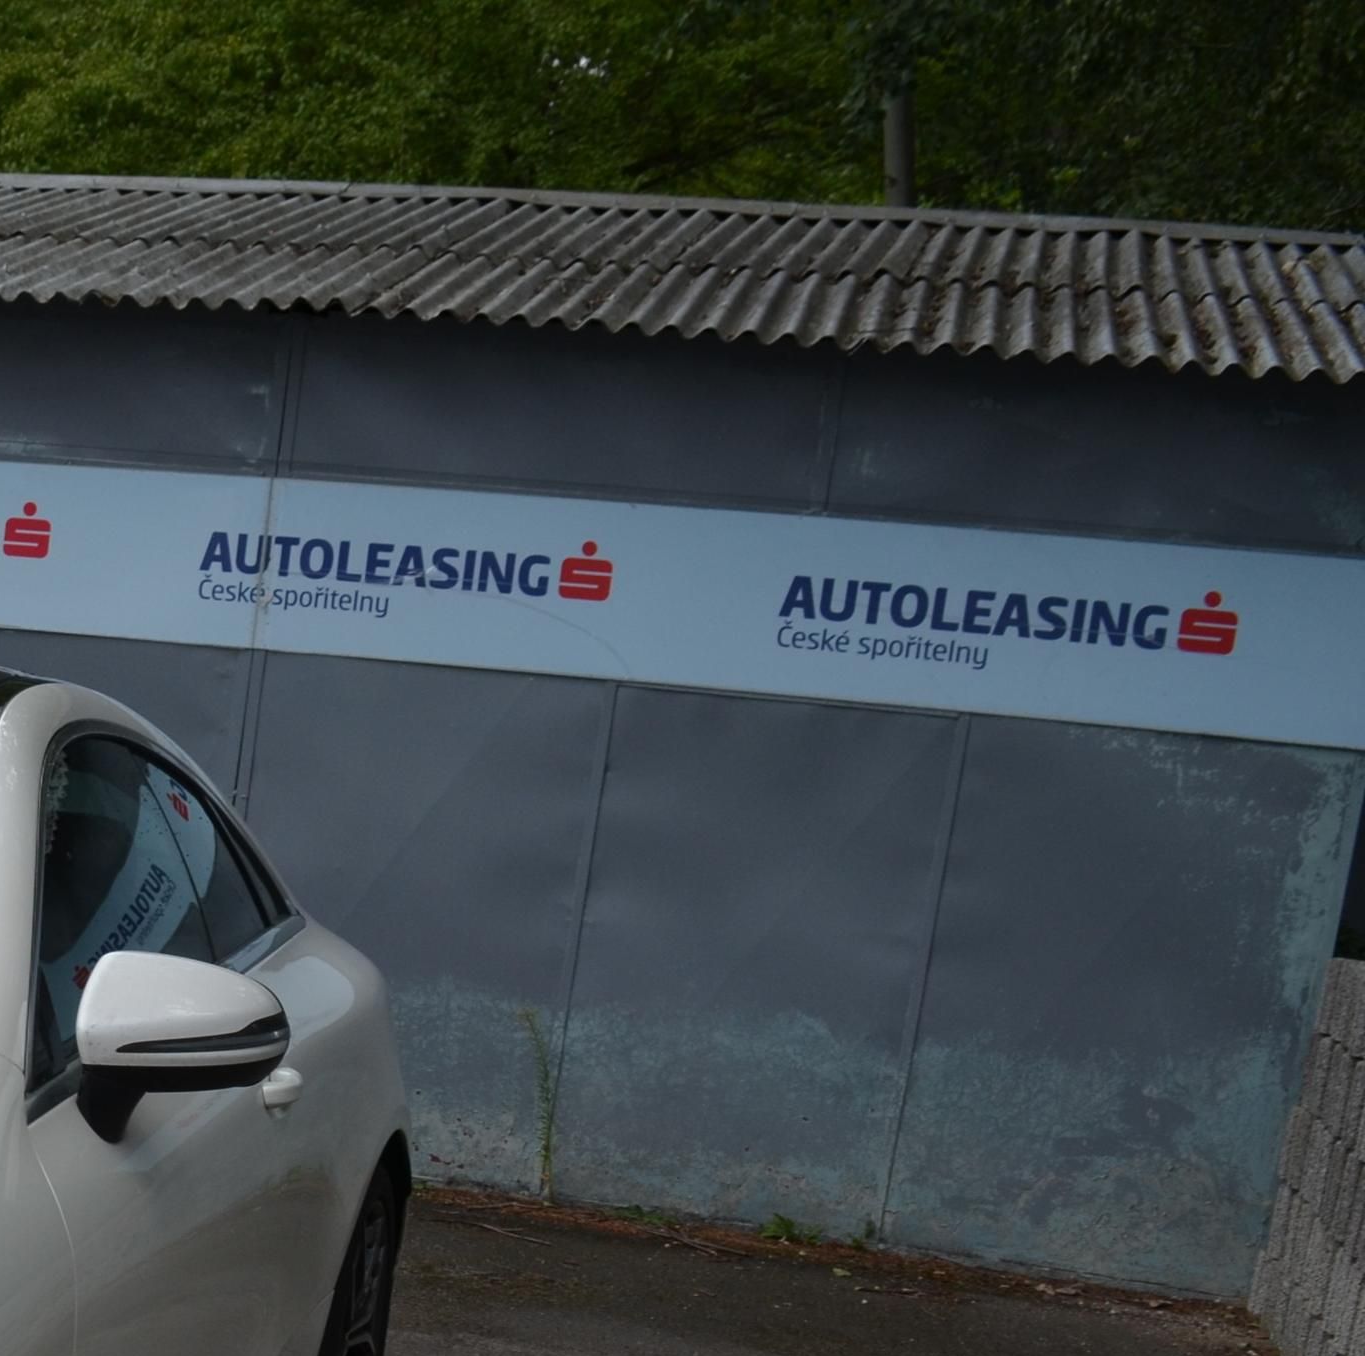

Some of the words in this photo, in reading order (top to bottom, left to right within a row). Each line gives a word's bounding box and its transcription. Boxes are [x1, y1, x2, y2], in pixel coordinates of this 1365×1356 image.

[199, 530, 552, 597] AUTOLEASING
[198, 573, 267, 604] České
[271, 584, 390, 618] spořitelny
[778, 574, 1170, 650] AUTOLEASING
[776, 622, 851, 654] České
[857, 635, 989, 671] spořitelny
